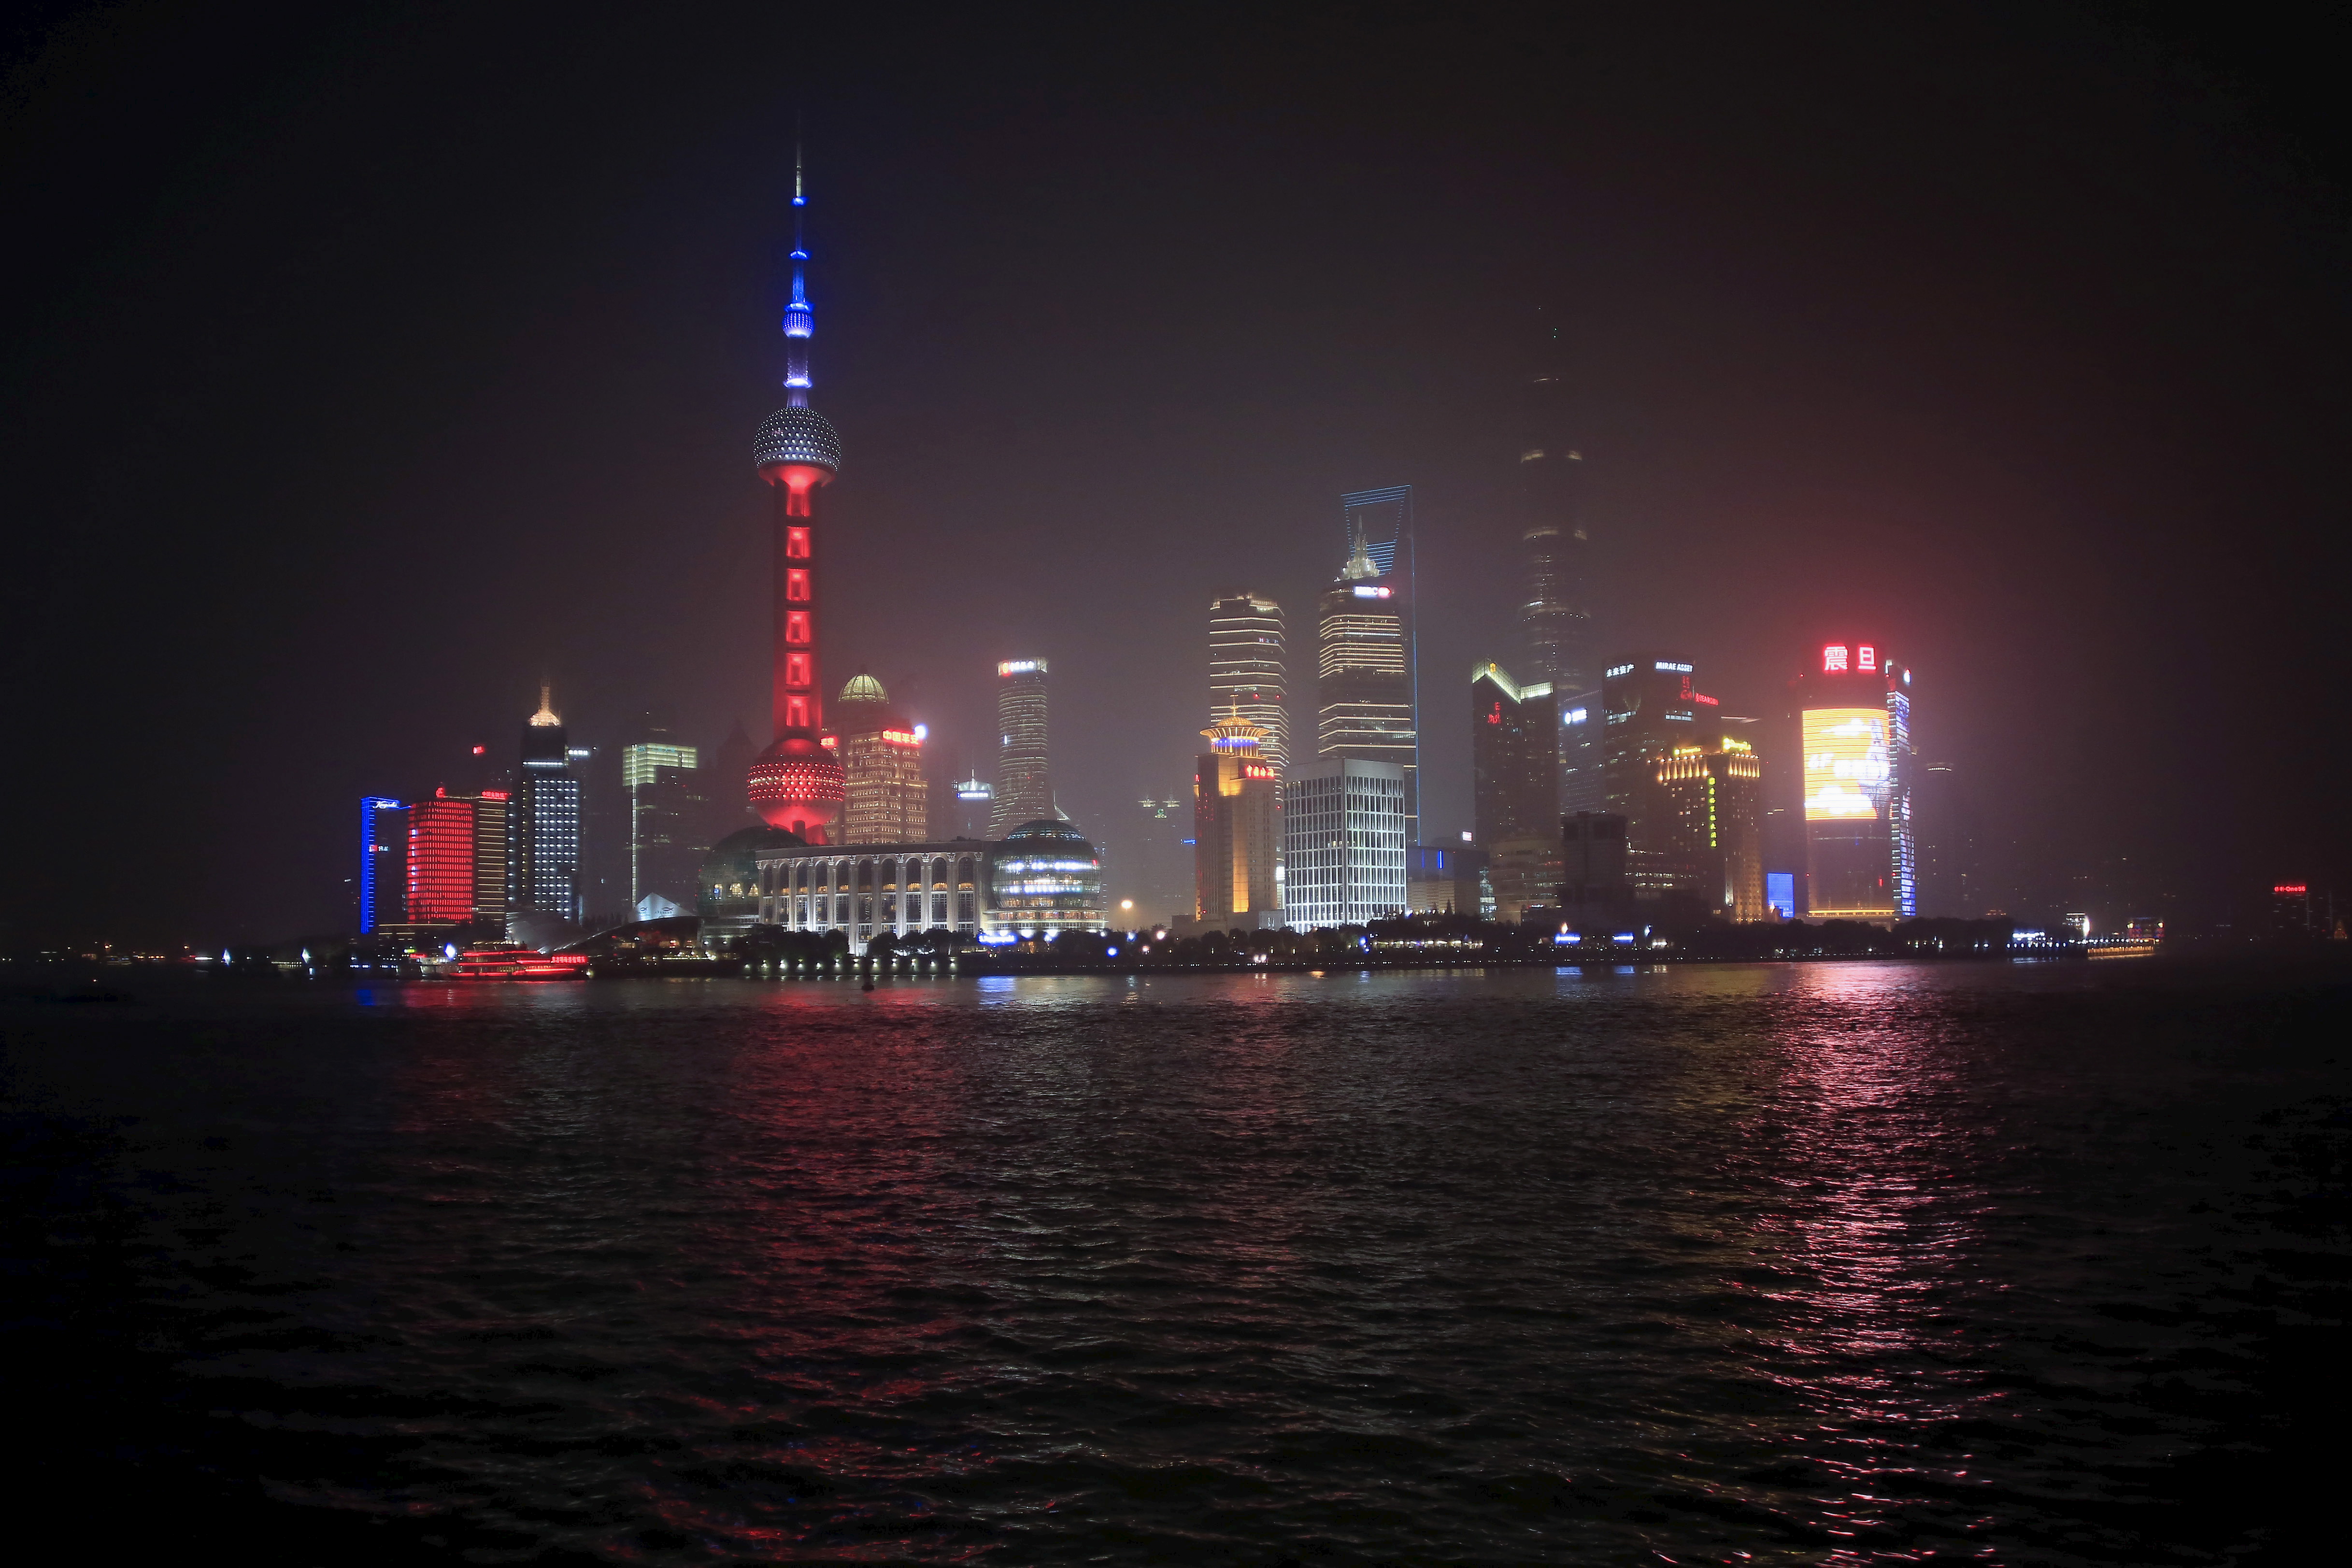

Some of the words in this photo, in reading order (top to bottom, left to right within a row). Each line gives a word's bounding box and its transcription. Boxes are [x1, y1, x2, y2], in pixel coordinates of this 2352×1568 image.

[1824, 645, 1877, 670] 震旦
[1607, 664, 1635, 677] 未来资产
[1656, 662, 1676, 670] MIRAE
[1677, 663, 1693, 672] ASSET
[883, 730, 919, 744] 中国平安
